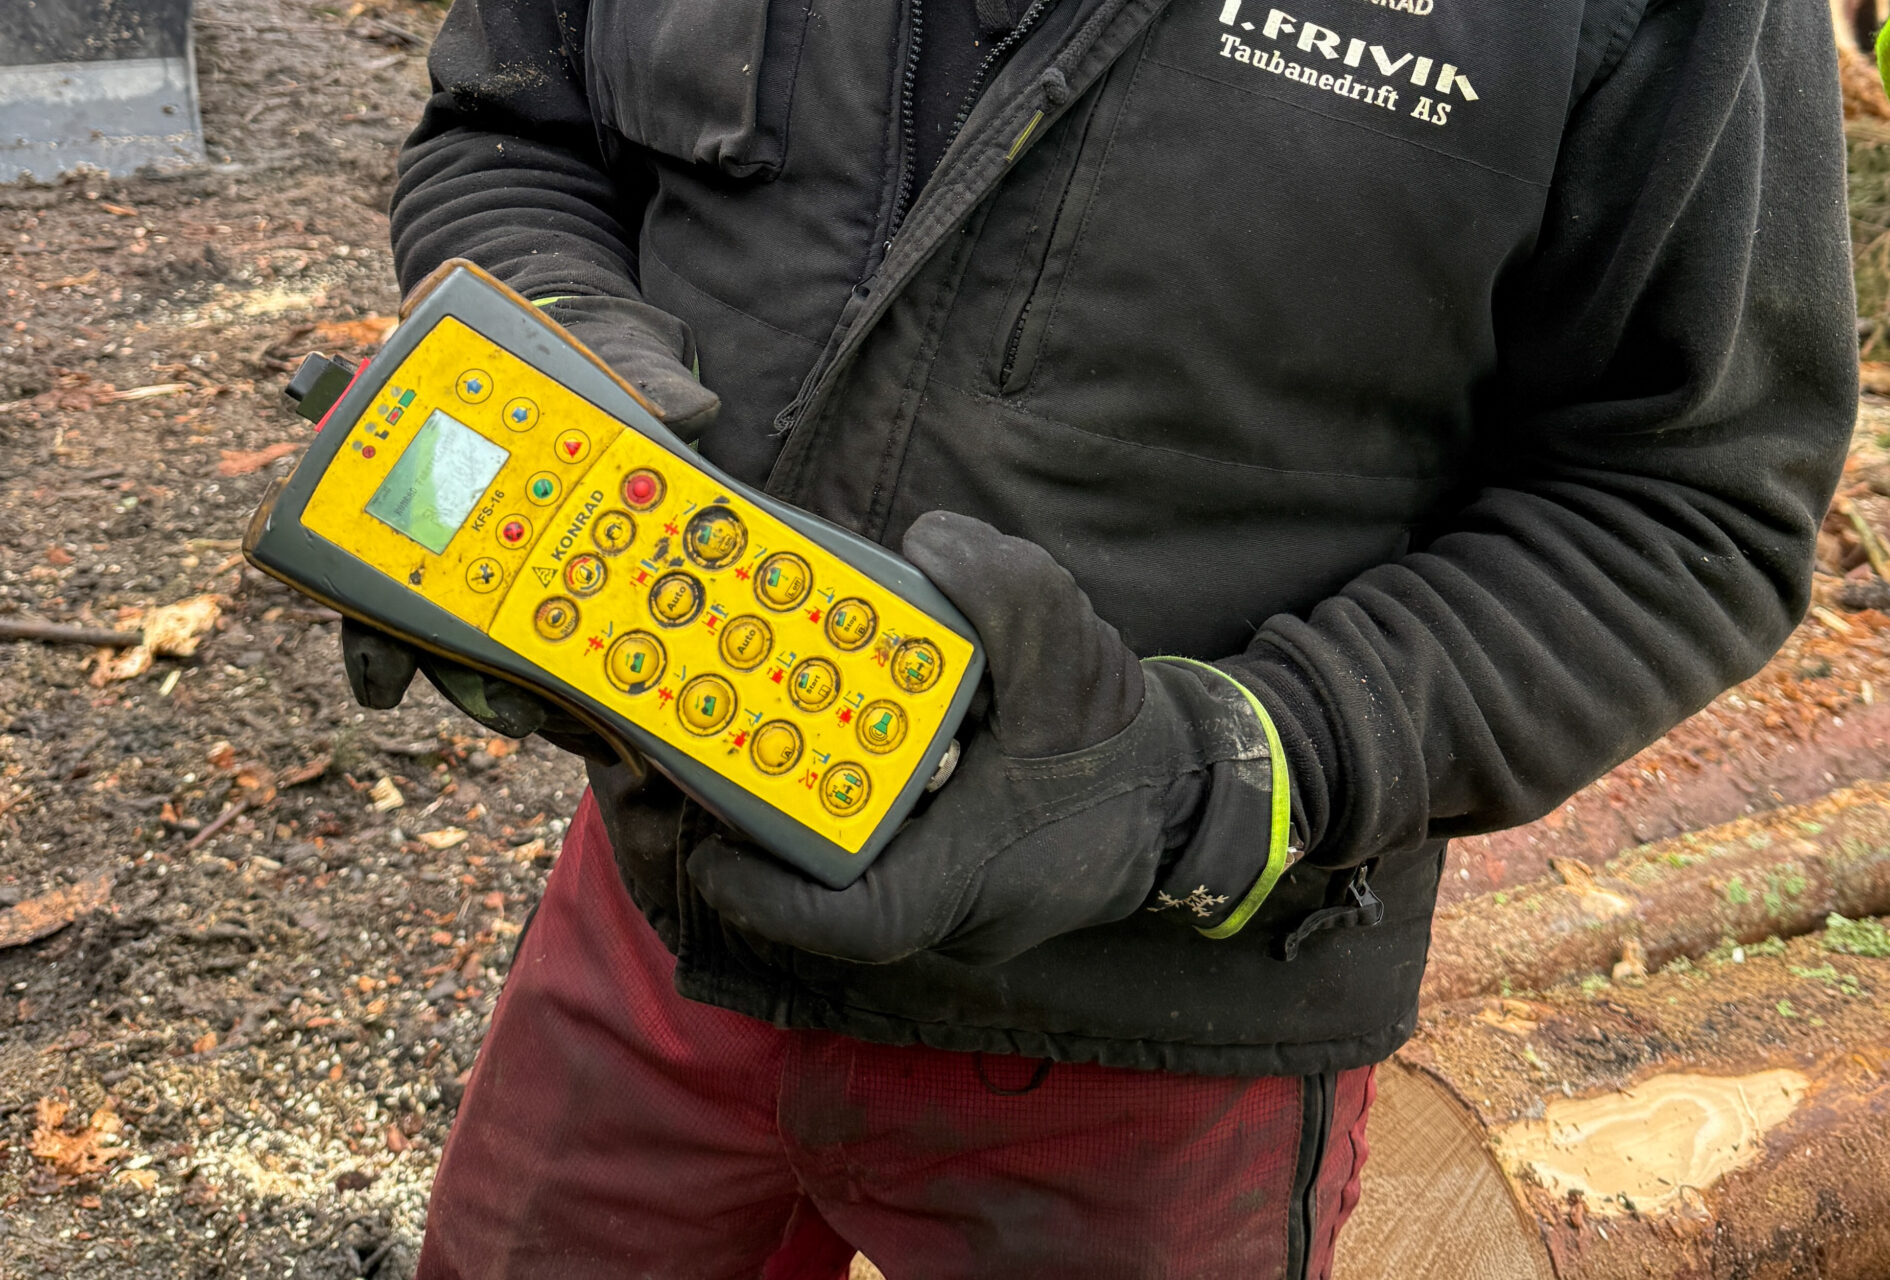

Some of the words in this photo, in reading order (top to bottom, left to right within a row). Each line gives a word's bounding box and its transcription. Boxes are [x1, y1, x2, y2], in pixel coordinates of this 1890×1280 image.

[1218, 33, 1400, 111] Taubanedrift
[1409, 95, 1453, 127] AS
[471, 489, 506, 533] KFS-16
[550, 489, 606, 563] KONRAD
[667, 585, 688, 613] Auto
[737, 628, 757, 656] Auto
[843, 615, 858, 633] Stop
